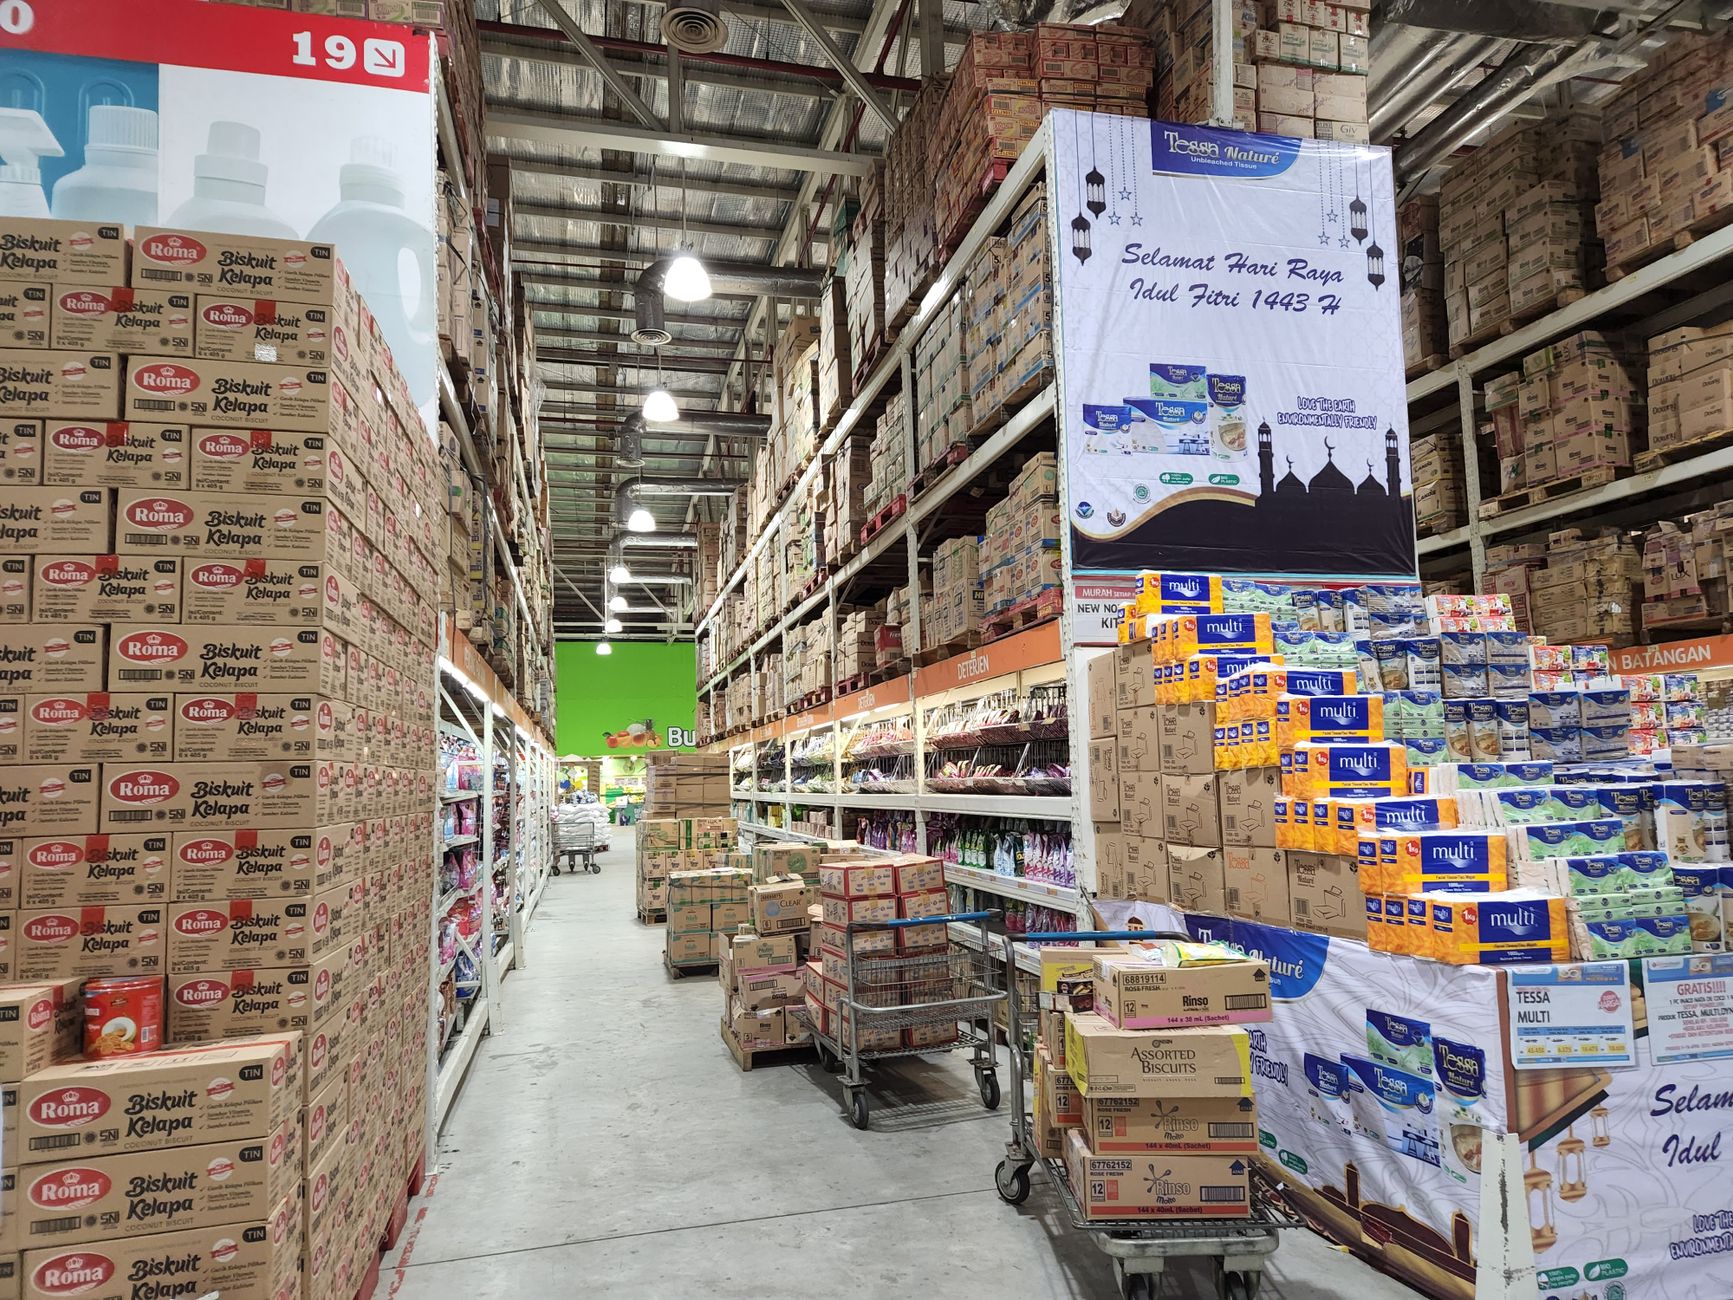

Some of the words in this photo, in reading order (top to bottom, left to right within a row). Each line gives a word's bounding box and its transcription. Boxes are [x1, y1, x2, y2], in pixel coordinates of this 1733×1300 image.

[293, 30, 357, 70] 19
[1164, 131, 1219, 158] Tessa
[1224, 147, 1279, 164] Naturé
[1191, 156, 1233, 167] Unbleached
[1234, 161, 1257, 169] Tissue
[101, 229, 118, 239] TIN
[1, 234, 61, 252] Biskuit
[150, 245, 197, 260] Roma
[218, 250, 277, 270] Biskuit
[313, 248, 329, 257] TIN
[1, 252, 57, 271] Kelapa
[1121, 243, 1216, 271] Selamat
[1224, 252, 1278, 277] Hari
[1286, 258, 1344, 287] Raya
[219, 269, 273, 288] Kelapa
[1130, 278, 1179, 301] Idul
[1189, 284, 1240, 308] Fitri
[1252, 290, 1310, 312] 1443
[1318, 295, 1342, 315] H
[66, 299, 105, 312] Roma
[209, 311, 247, 323] Roma
[254, 328, 298, 341] Kelapa
[143, 373, 191, 389] Roma
[310, 373, 325, 382] TIN
[212, 378, 271, 396] Biskuit
[1212, 378, 1241, 393] Tessa
[213, 397, 268, 416] Kelapa
[1156, 402, 1185, 416] Tessa
[1297, 396, 1317, 411] LOVE
[1317, 397, 1333, 412] THE
[1333, 399, 1355, 413] EARTH
[1096, 411, 1118, 422] Tessa
[1277, 412, 1343, 429] ENVIRONMENTALLY
[1344, 415, 1377, 430] FRIENDLY
[252, 457, 296, 471] Kelapa
[304, 503, 320, 513] TIN
[136, 509, 184, 524] Roma
[205, 511, 266, 529] Biskuit
[205, 529, 262, 547] Kelapa
[1082, 589, 1113, 597] MURAH
[1169, 579, 1199, 592] multi
[246, 587, 290, 601] Kelapa
[1078, 604, 1100, 613] NEW
[1207, 618, 1243, 634] multi
[301, 632, 317, 641] TIN
[128, 642, 179, 656] Roma
[200, 643, 263, 660] Biskuit
[1622, 644, 1712, 670] BATANGAN
[201, 662, 258, 680] Kelapa
[957, 654, 990, 681] DETERJEN
[1297, 676, 1332, 689] multi
[1320, 702, 1356, 717] multi
[237, 722, 283, 736] Kelapa
[1340, 752, 1378, 769] multi
[293, 767, 309, 776] TIN
[120, 781, 170, 797] Roma
[191, 780, 254, 799] Biskuit
[1611, 791, 1638, 804] Tessa
[191, 800, 250, 818] Kelapa
[1386, 805, 1426, 824] multi
[36, 850, 76, 862] Roma
[187, 847, 226, 859] Roma
[1433, 840, 1475, 860] multi
[236, 861, 282, 876] Kelapa
[141, 912, 158, 922] TIN
[182, 917, 221, 930] Roma
[1490, 908, 1536, 928] multi
[31, 923, 71, 936] Roma
[231, 931, 277, 946] Kelapa
[1124, 974, 1165, 983] 68819114
[183, 987, 222, 1000] Roma
[1677, 981, 1726, 995] GRATIS!!!!
[1183, 996, 1209, 1007] Rinso
[1516, 991, 1550, 1003] TESSA
[231, 998, 279, 1013] Kelapa
[1126, 1003, 1134, 1012] 12
[1384, 1015, 1408, 1032] Tessa
[1518, 1011, 1550, 1023] MULTI
[1131, 1047, 1196, 1062] ASSORTED
[1439, 1046, 1478, 1074] Tessa
[243, 1066, 261, 1078] TIN
[1142, 1061, 1196, 1073] BISCUITS
[1316, 1065, 1340, 1085] Tessa
[1374, 1068, 1408, 1095] Tessa
[124, 1090, 198, 1115] Biskuit
[1057, 1096, 1067, 1106] 12
[40, 1102, 99, 1118] Roma
[126, 1115, 193, 1138] Kelapa
[1100, 1119, 1111, 1130] 12
[1164, 1117, 1199, 1132] Rinso
[124, 1139, 162, 1150] COCONUT
[164, 1135, 193, 1144] BISCUIT
[1662, 1132, 1722, 1167] Idul
[243, 1149, 261, 1159] TIN
[1091, 1161, 1131, 1169] 67762152
[125, 1171, 198, 1197] Biskuit
[1093, 1183, 1103, 1194] 12
[1156, 1181, 1191, 1195] Rinso
[42, 1184, 99, 1200] Roma
[127, 1198, 193, 1221] Kelapa
[125, 1222, 162, 1232] COCONUT
[165, 1217, 194, 1226] BISCUIT
[1693, 1213, 1716, 1233] LOVE
[246, 1228, 264, 1240] TIN
[128, 1253, 201, 1280] Biskuit
[45, 1267, 103, 1285] Roma
[131, 1278, 197, 1300] Kelapa
